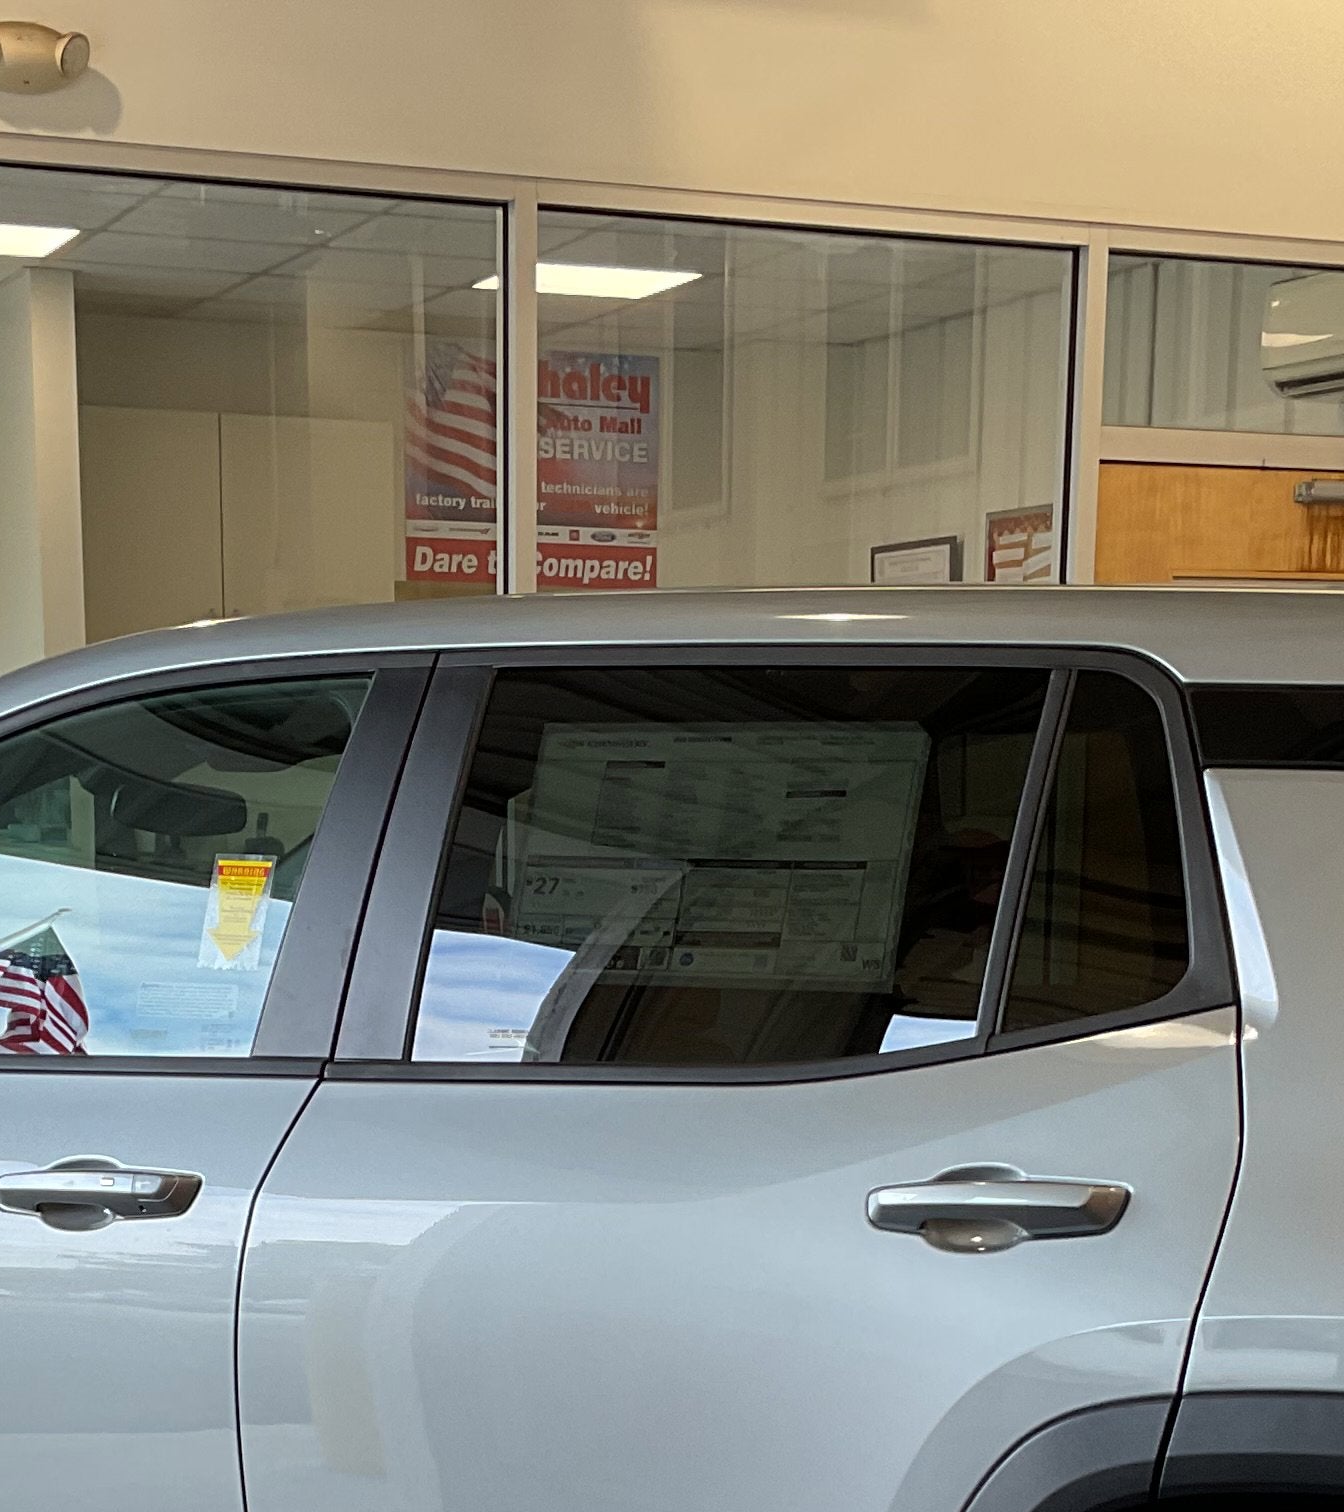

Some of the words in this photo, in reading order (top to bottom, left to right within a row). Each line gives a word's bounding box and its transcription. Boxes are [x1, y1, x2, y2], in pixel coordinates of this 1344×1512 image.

[537, 360, 651, 414] haley
[599, 415, 642, 434] Mall
[538, 437, 649, 463] SERVICE
[541, 481, 621, 500] technicians
[626, 487, 649, 499] are
[415, 494, 466, 512] factory
[594, 503, 649, 516] vehicle!
[414, 546, 479, 574] Dare
